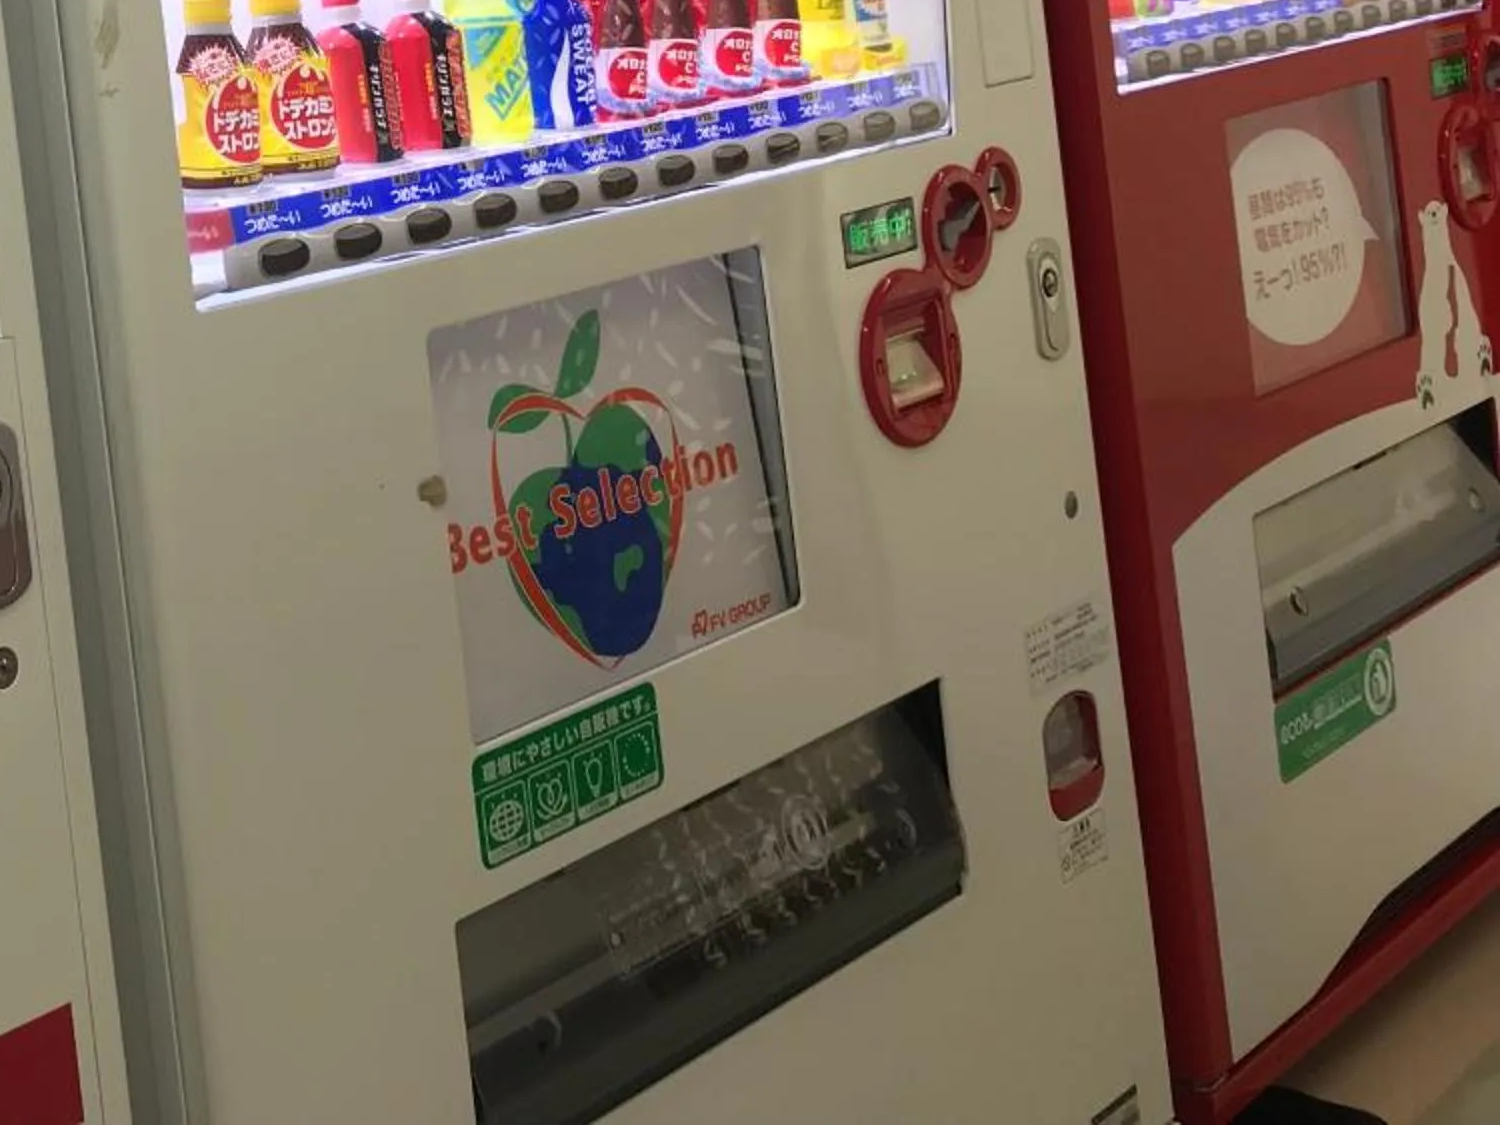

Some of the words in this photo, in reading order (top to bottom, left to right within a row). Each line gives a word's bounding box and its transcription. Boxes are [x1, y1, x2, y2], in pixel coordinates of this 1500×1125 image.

[447, 504, 539, 574] Best
[548, 441, 739, 540] Selection
[729, 592, 772, 626] GROUP
